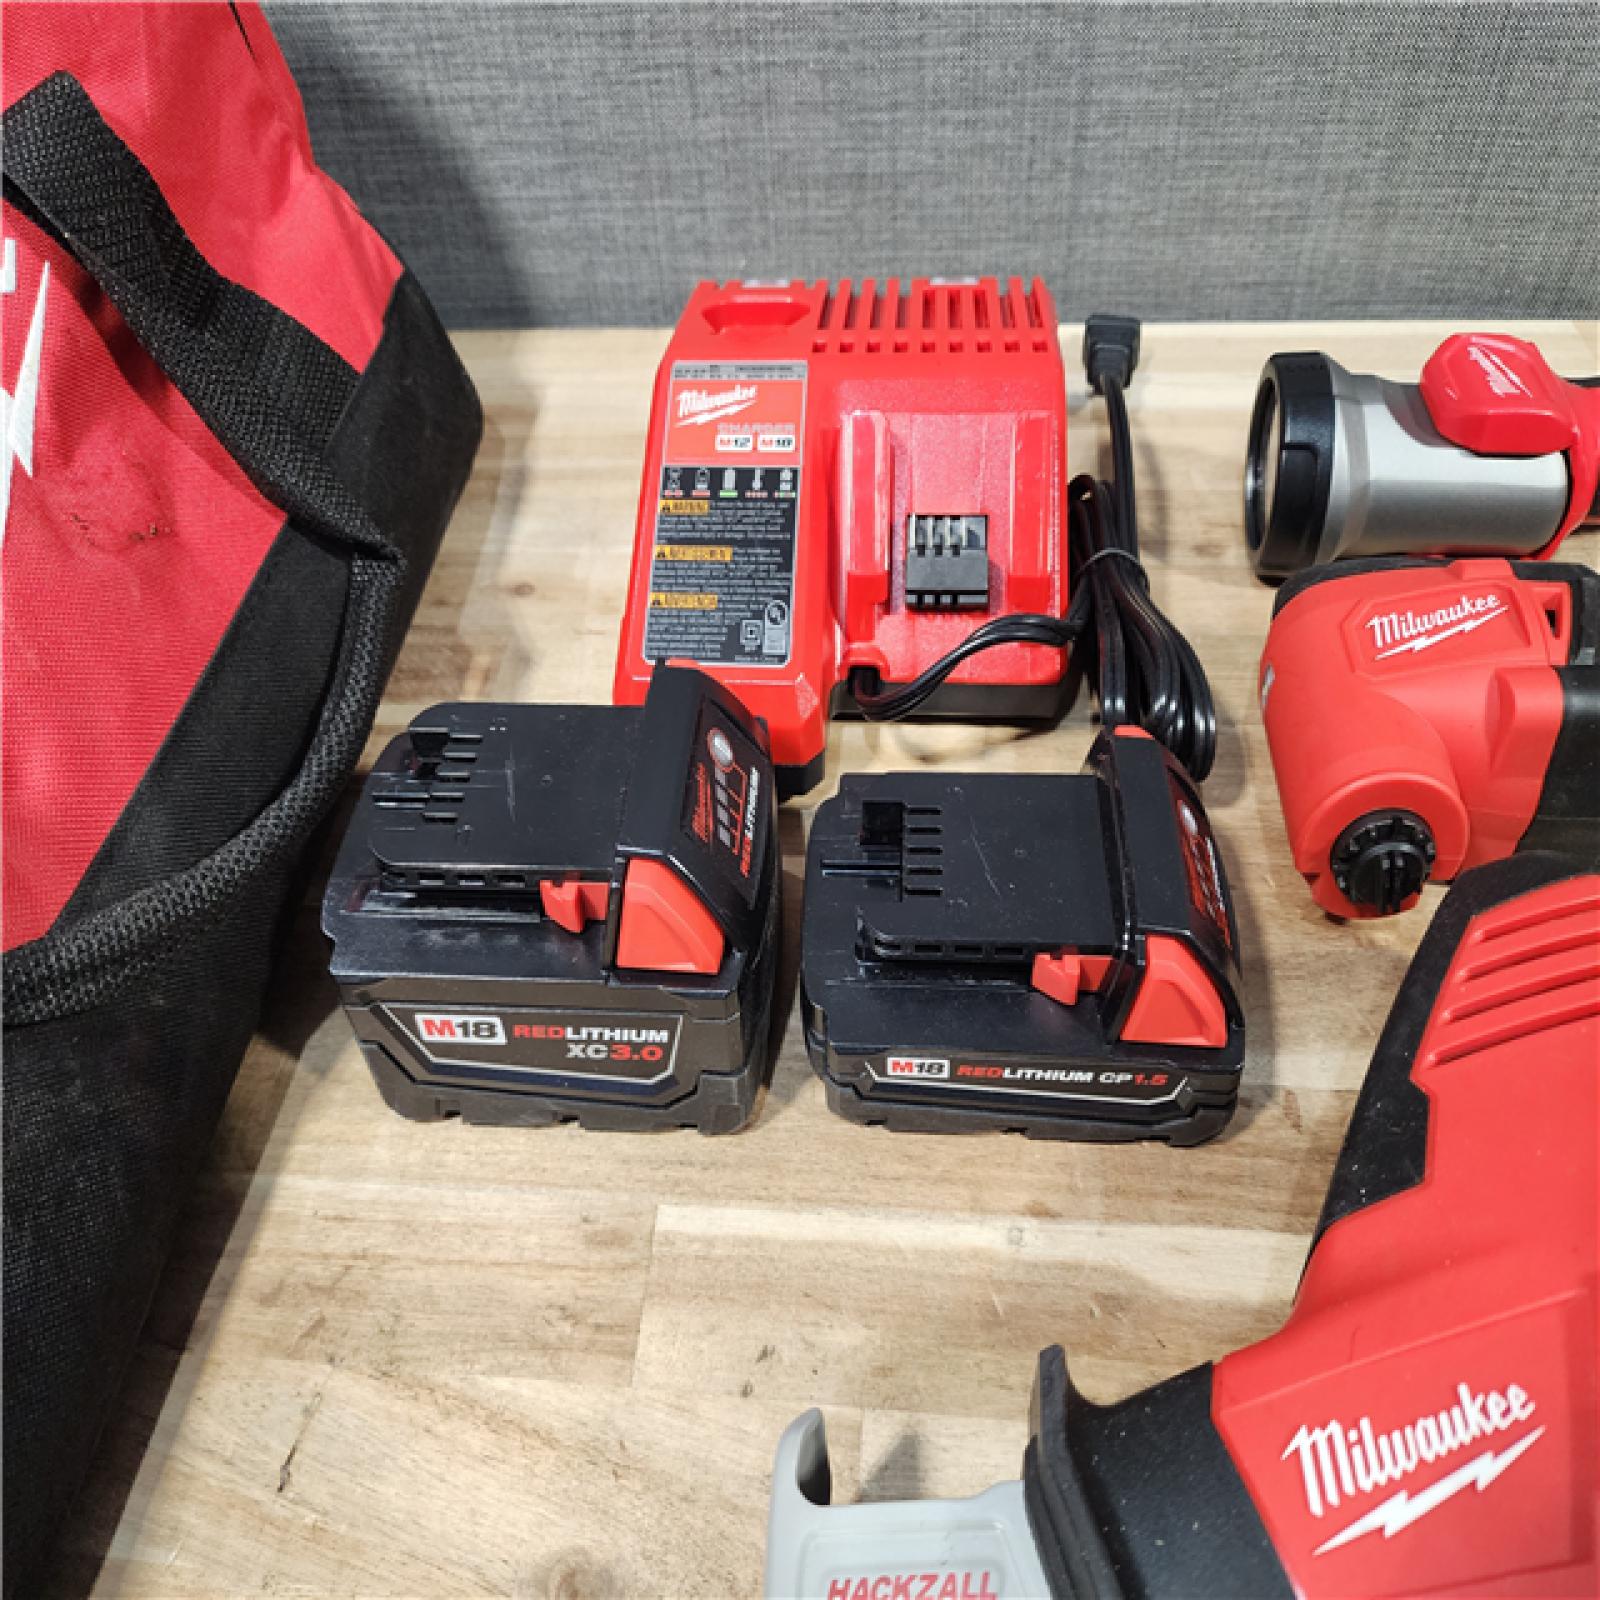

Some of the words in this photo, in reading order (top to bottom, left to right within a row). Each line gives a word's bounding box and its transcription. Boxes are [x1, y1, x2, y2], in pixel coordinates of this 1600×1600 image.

[1365, 594, 1501, 648] Milwaukee
[422, 1018, 502, 1040] M18
[512, 1024, 670, 1043] REDLITHIUM
[891, 1058, 946, 1075] M18
[956, 1064, 1094, 1083] REDLITHIUM
[1280, 1381, 1536, 1519] Milwaukee
[827, 1569, 999, 1600] HACKZALL
